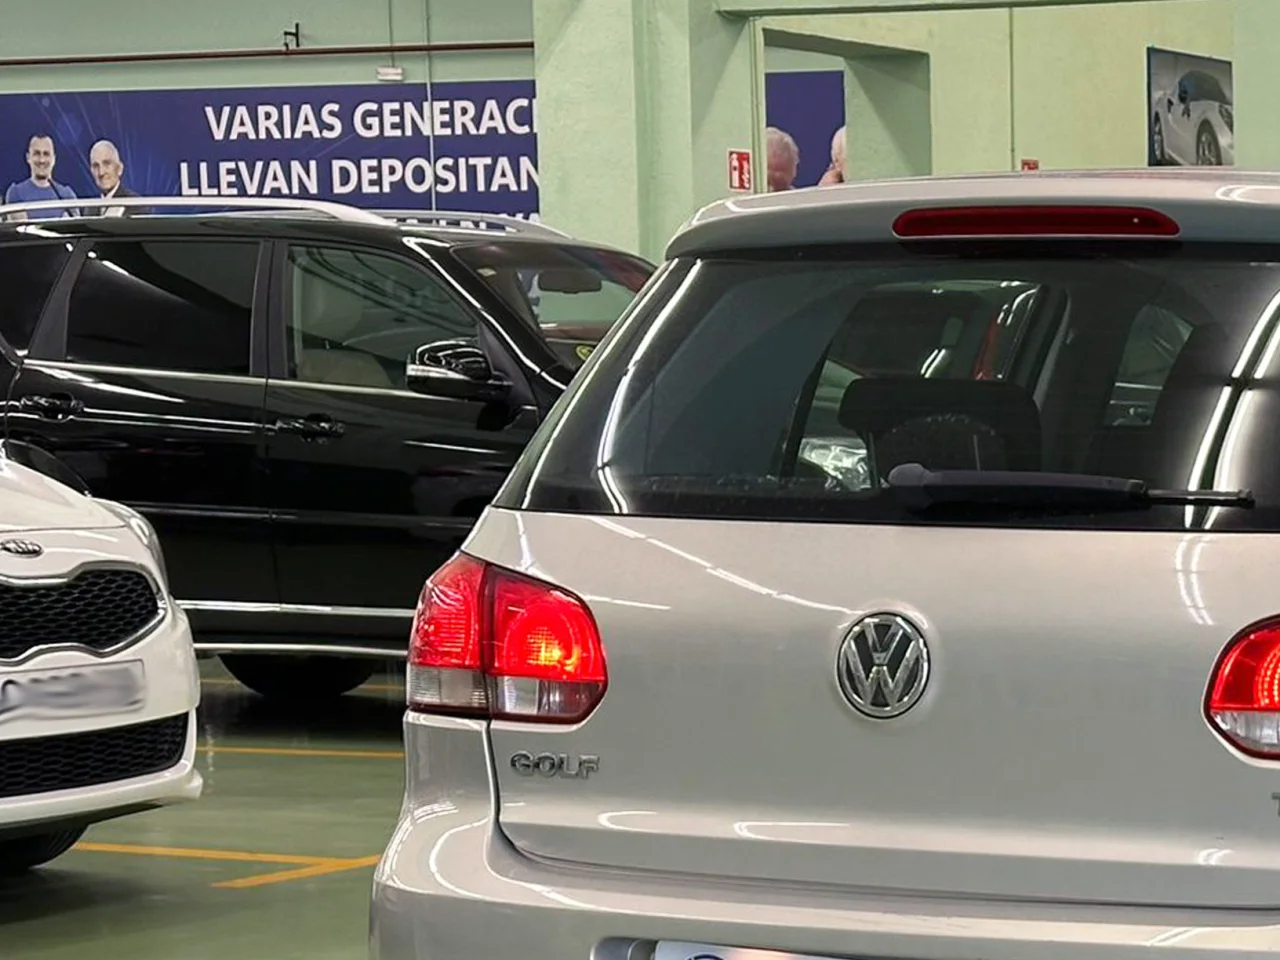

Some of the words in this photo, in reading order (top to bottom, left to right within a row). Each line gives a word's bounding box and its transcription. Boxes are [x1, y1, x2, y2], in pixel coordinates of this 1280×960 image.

[204, 102, 342, 141] VARIAS
[179, 159, 318, 196] LLEVAN
[510, 751, 600, 780] GOLF
